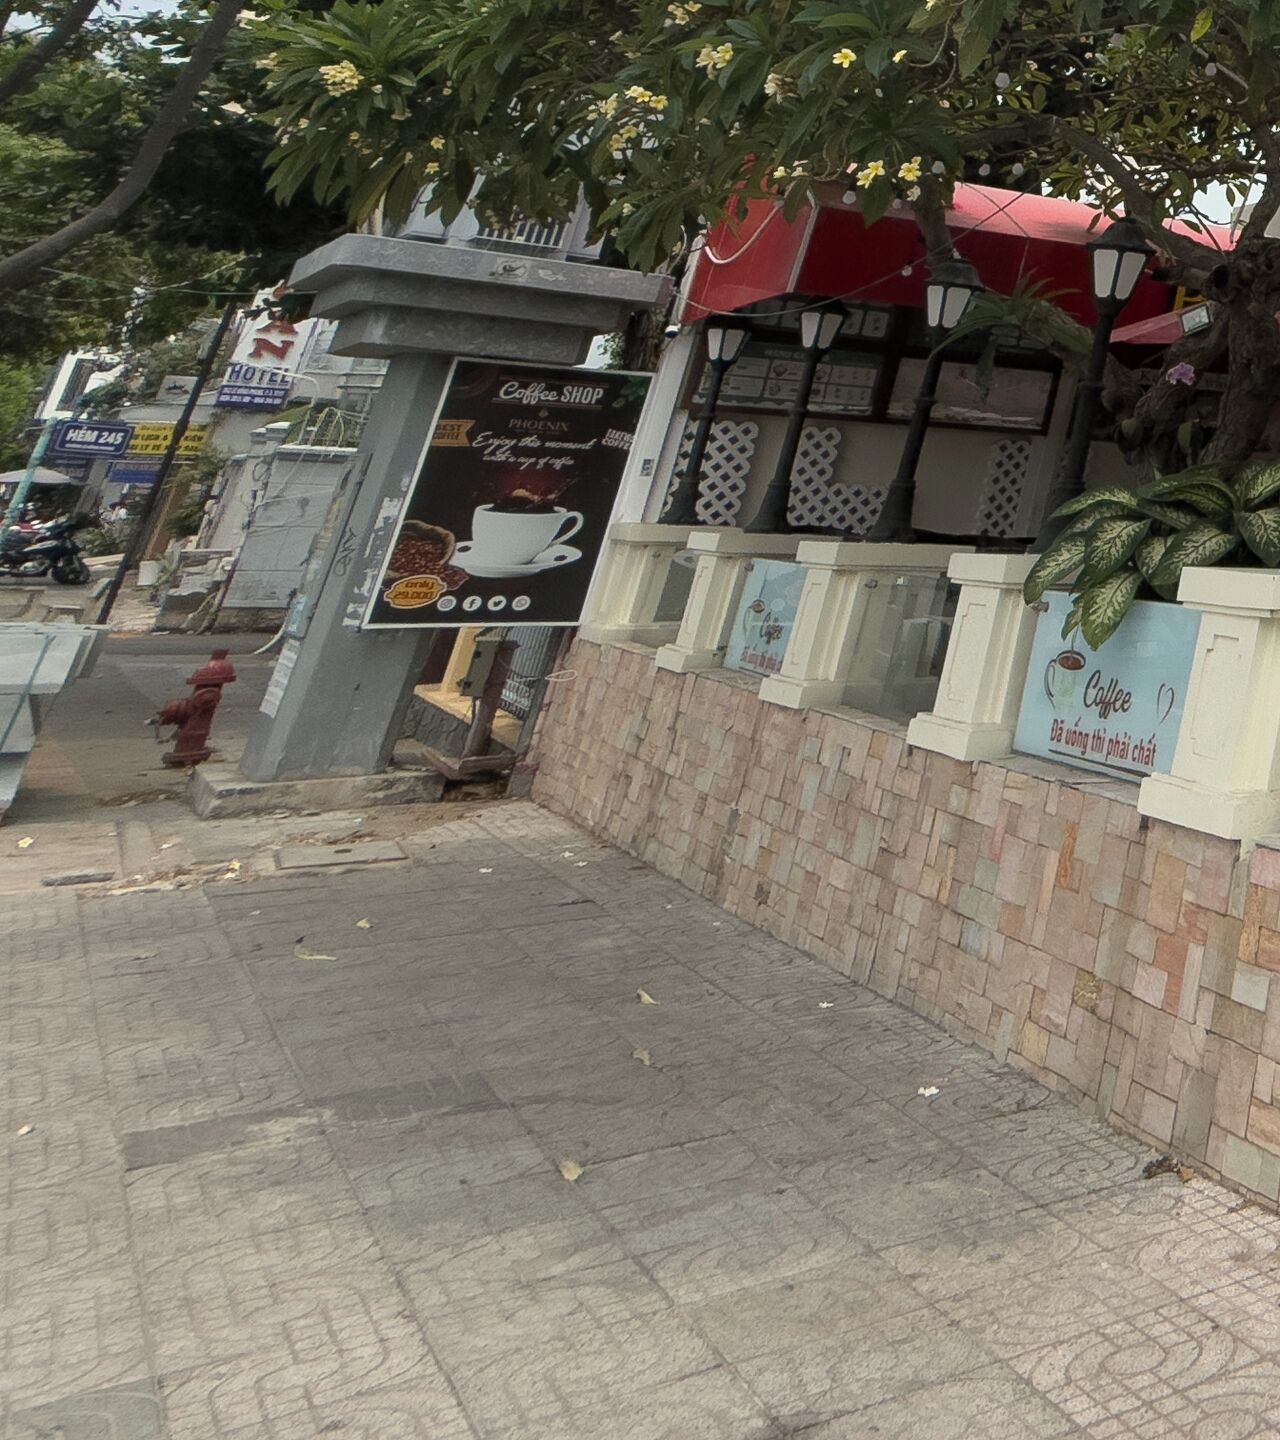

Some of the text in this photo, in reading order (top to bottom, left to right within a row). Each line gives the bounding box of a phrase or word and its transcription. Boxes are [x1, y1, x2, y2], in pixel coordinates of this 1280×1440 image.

[228, 363, 291, 386] HOTEL
[499, 381, 605, 405] Coffee SHOP
[508, 418, 569, 432] PHOENIX
[98, 431, 125, 445] 245
[471, 431, 515, 455] Enjoy
[518, 434, 541, 448] this
[544, 437, 597, 450] moment
[405, 580, 435, 591] only
[759, 610, 785, 644] Coffee
[1083, 669, 1132, 719] Coffee
[1050, 717, 1157, 767] Đã uống thì phải chất
